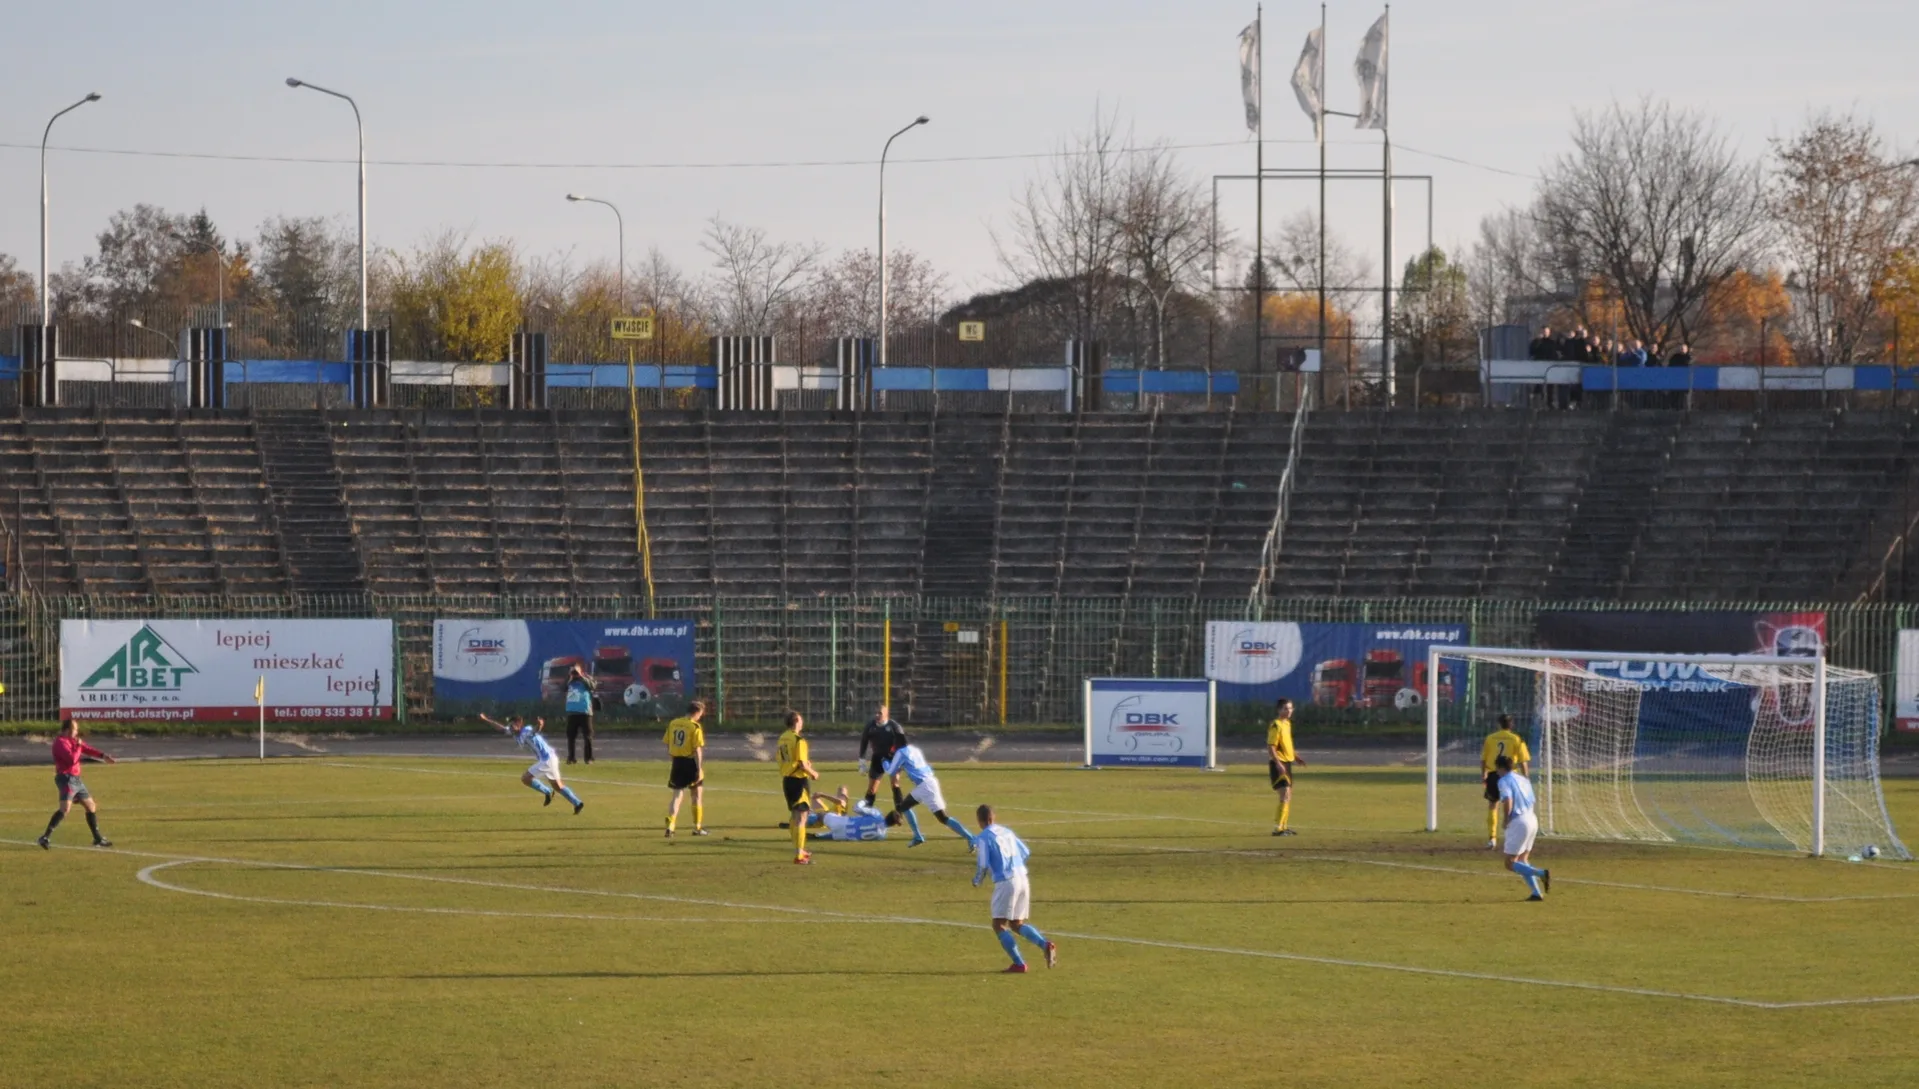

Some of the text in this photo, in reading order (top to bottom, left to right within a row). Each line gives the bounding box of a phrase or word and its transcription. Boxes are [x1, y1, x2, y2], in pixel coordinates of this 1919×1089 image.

[604, 625, 688, 639] www.dbk.com.pl
[1376, 629, 1460, 642] www.dbk.com.pl
[216, 630, 271, 651] lepiej
[468, 639, 506, 648] DBK
[1241, 641, 1277, 650] DBK
[253, 653, 345, 670] mieszkać
[1669, 680, 1728, 693] DRINK
[80, 693, 129, 702] ARBET
[132, 693, 148, 704] Sp.
[71, 708, 194, 720] www.arbet.olsztyn.pl
[275, 707, 297, 718] tel.:
[300, 708, 322, 718] 089
[325, 708, 346, 718] 535
[349, 708, 364, 717] 38
[1126, 713, 1179, 725] DBK
[673, 729, 685, 747] 19
